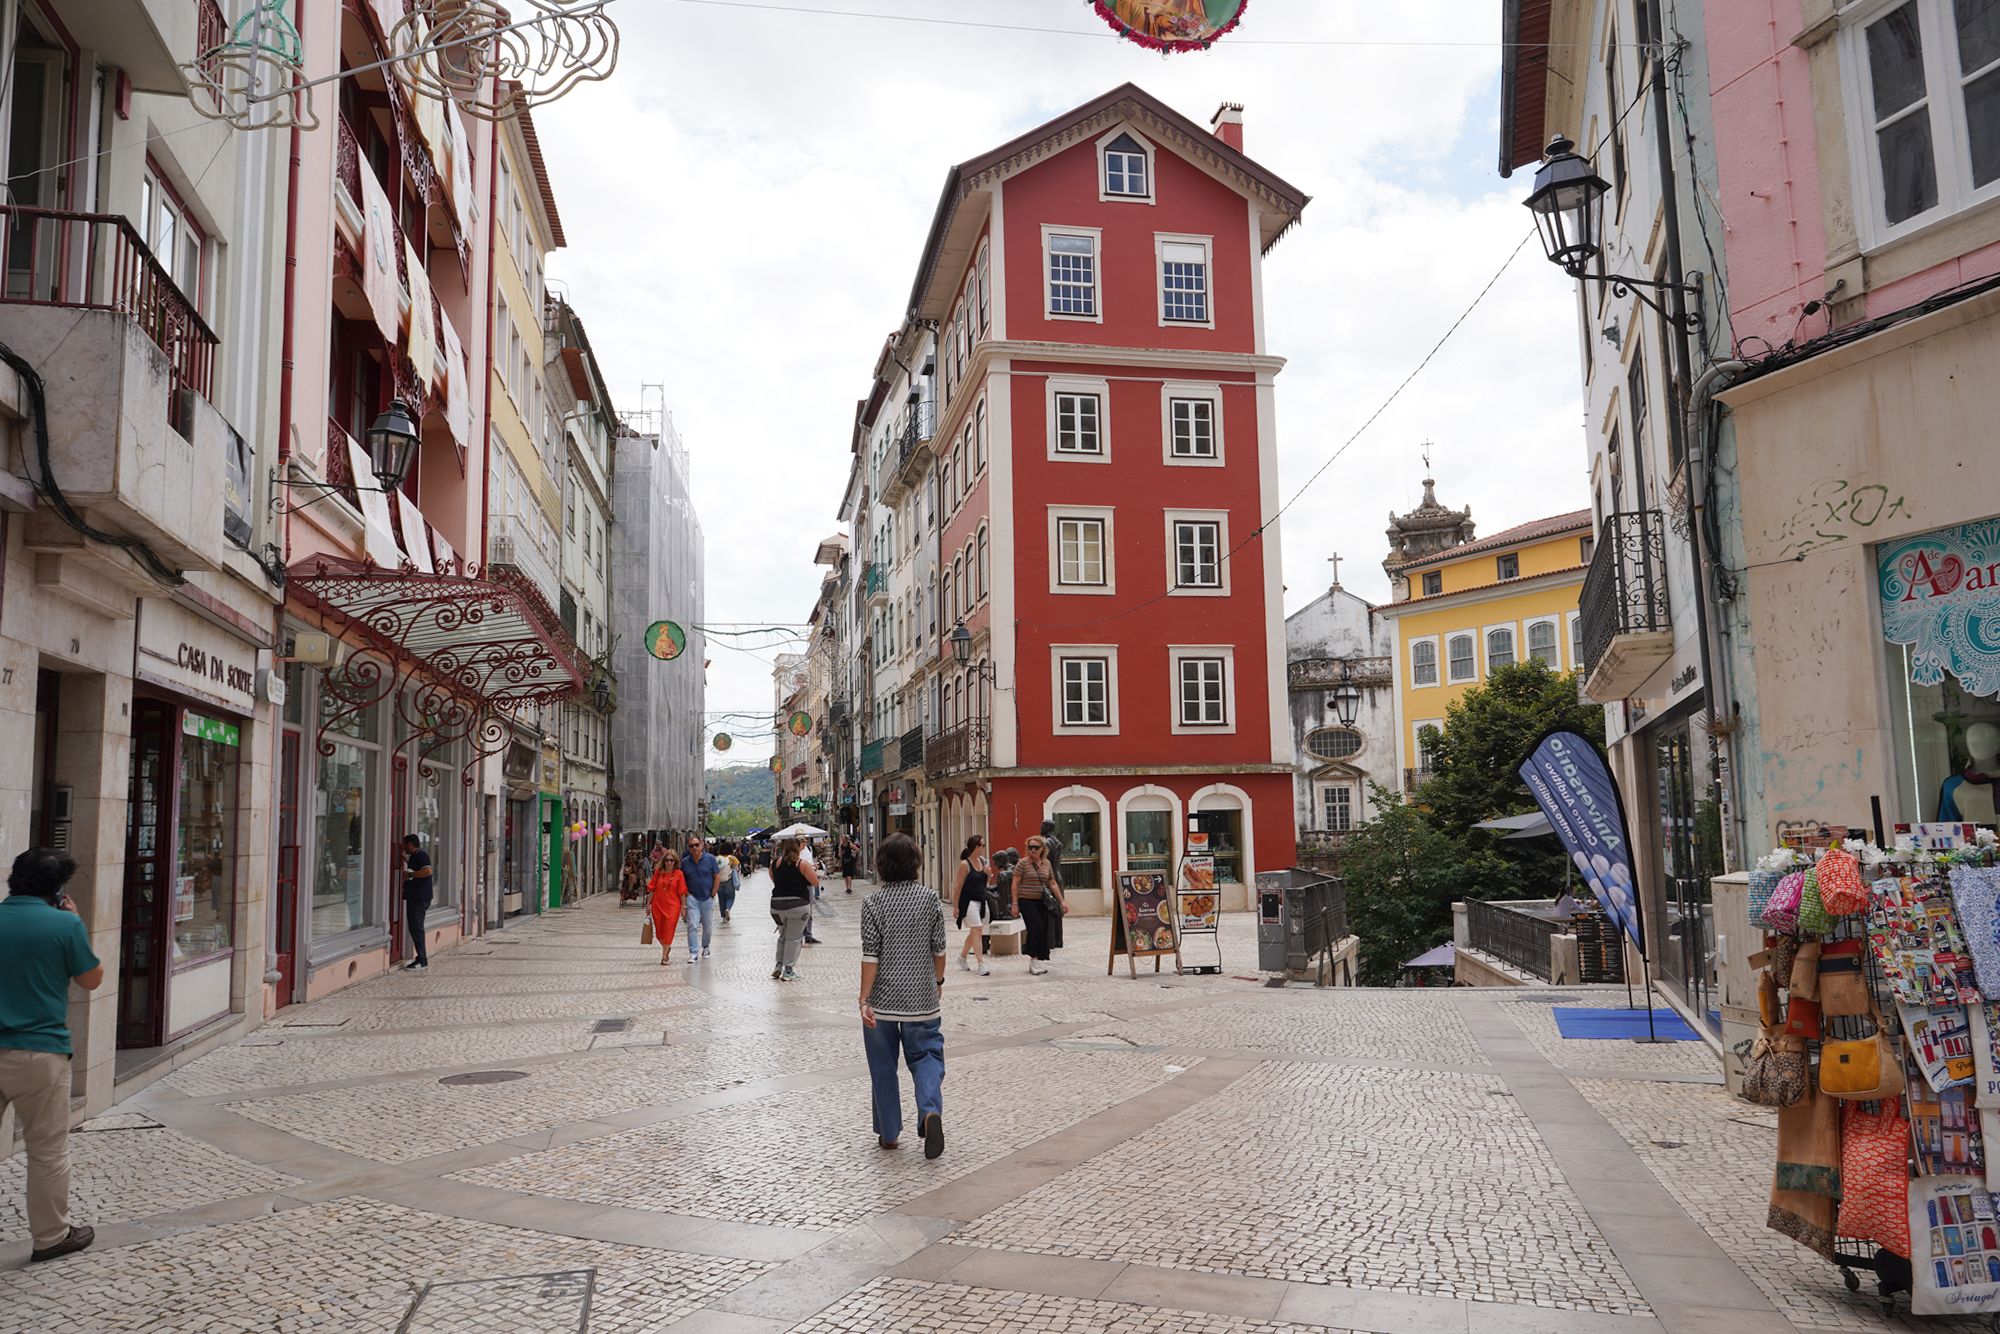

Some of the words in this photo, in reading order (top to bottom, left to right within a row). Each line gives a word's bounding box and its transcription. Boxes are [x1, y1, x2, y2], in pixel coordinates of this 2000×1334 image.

[2, 667, 14, 685] 77
[178, 642, 207, 677] CASA
[210, 655, 224, 684] DA
[227, 664, 255, 697] SORTE
[1945, 1288, 1999, 1307] Portugal
